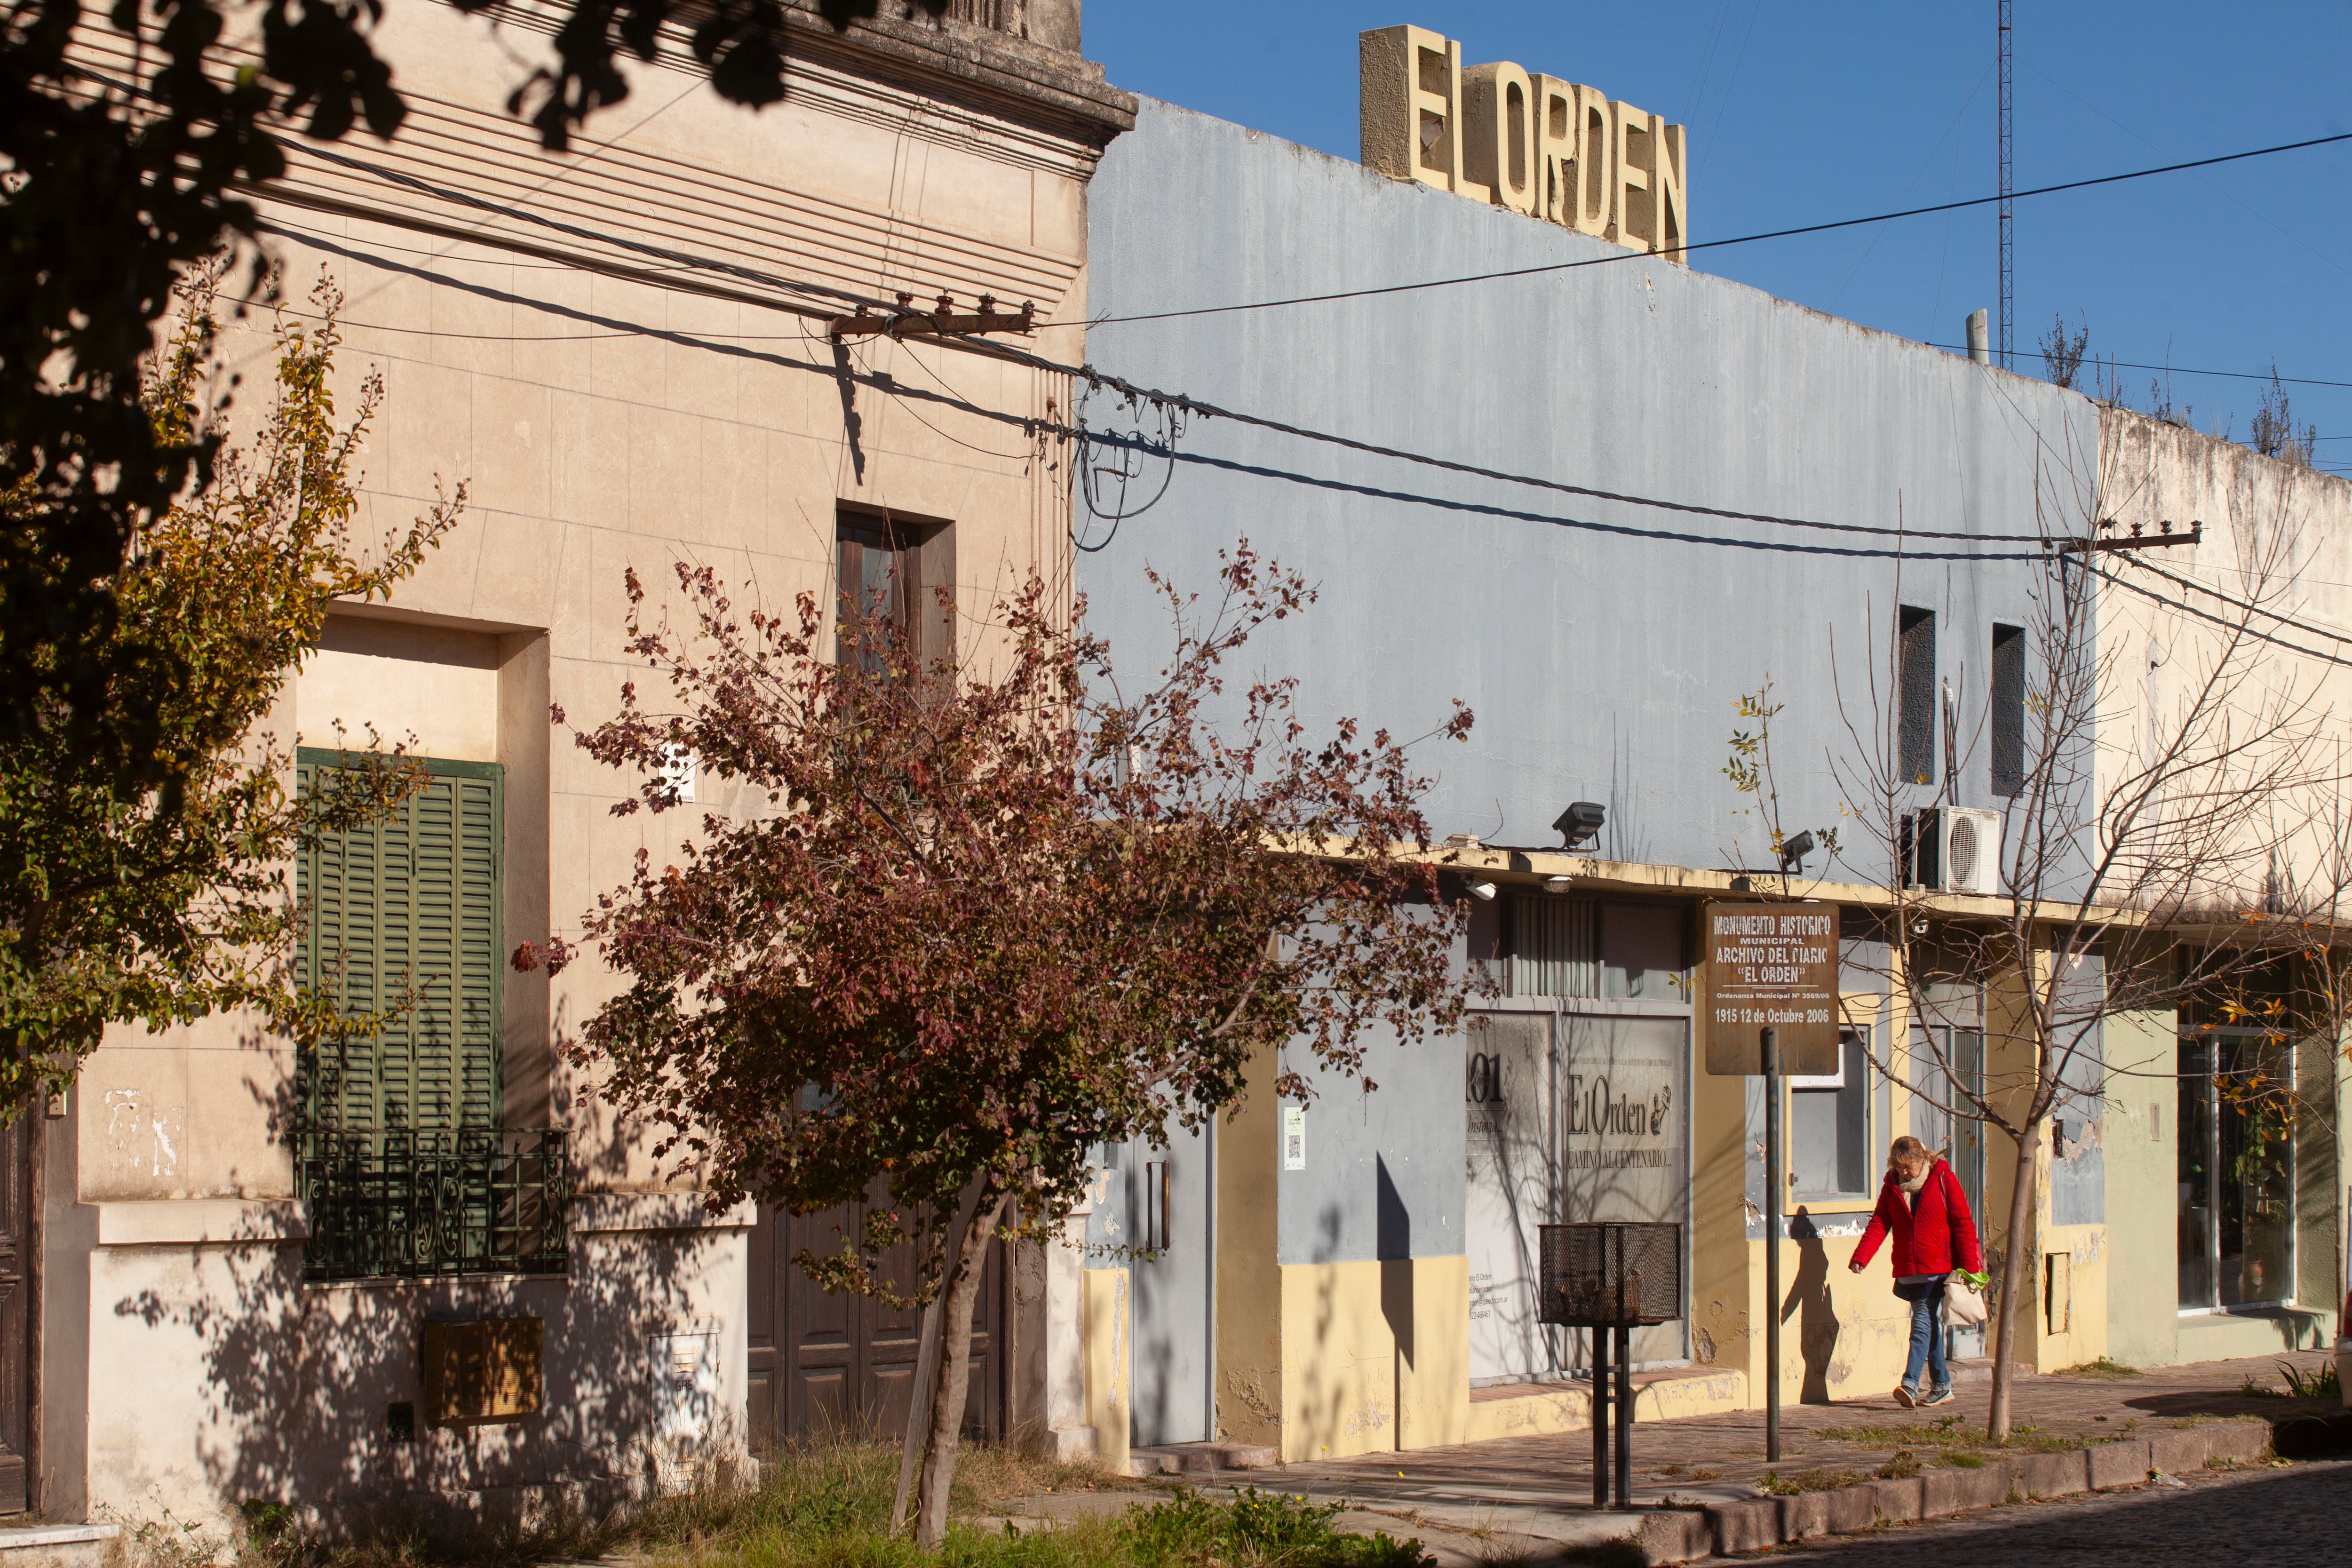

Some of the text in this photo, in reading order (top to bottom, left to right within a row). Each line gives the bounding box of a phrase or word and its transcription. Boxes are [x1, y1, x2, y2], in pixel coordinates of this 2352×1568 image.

[1407, 24, 1687, 264] EL ORDEN
[1714, 915, 1830, 935] MONUMENTO HISTORICO
[1716, 947, 1828, 963] ARCHIVO DEL DIARIO
[1716, 1008, 1828, 1023] 1915 12 de Octubre 2006
[1568, 1075, 1646, 1135] El Orden
[1568, 1150, 1601, 1169] CAMINO
[1603, 1151, 1613, 1169] AL
[676, 1379, 693, 1391] GAS
